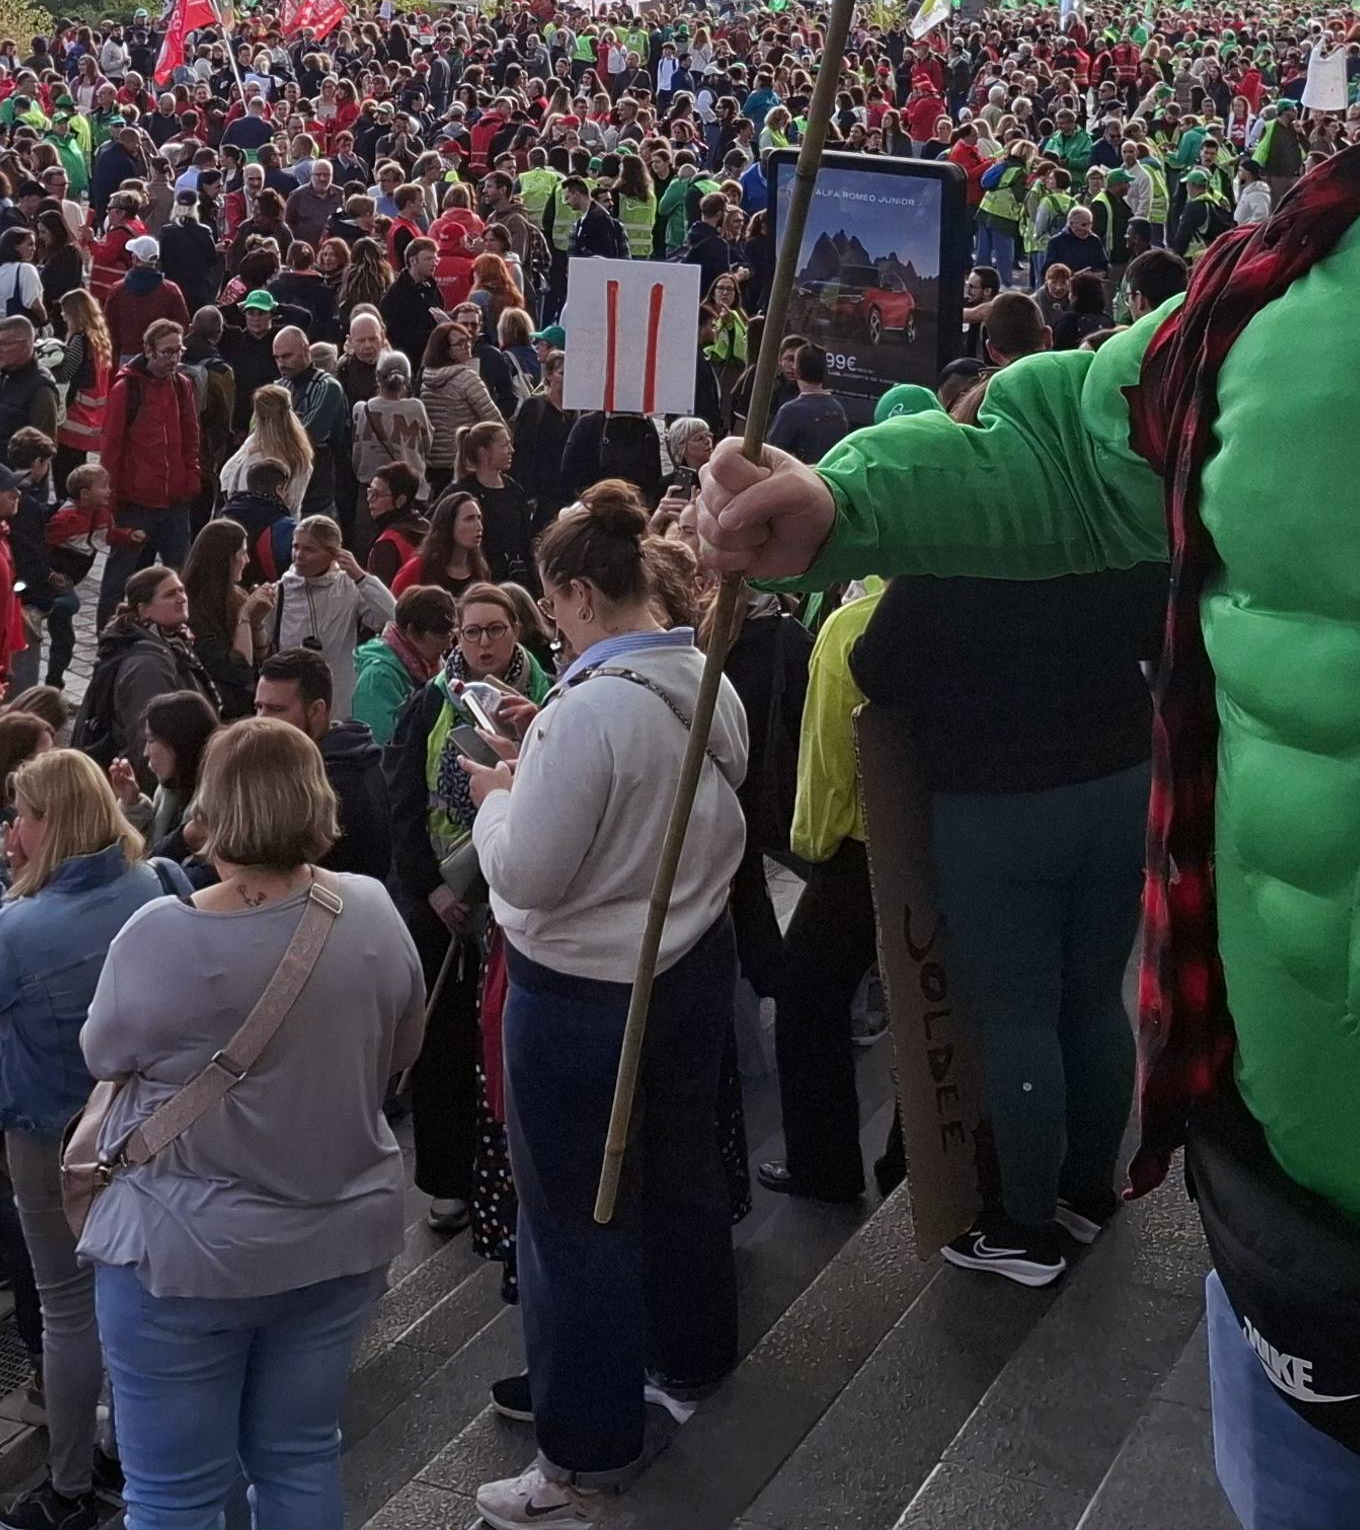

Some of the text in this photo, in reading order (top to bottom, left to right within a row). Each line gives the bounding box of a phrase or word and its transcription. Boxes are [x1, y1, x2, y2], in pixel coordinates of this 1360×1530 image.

[815, 188, 916, 207] ALFA ROMEO JUNIOR
[1243, 1316, 1313, 1390] NIKE
